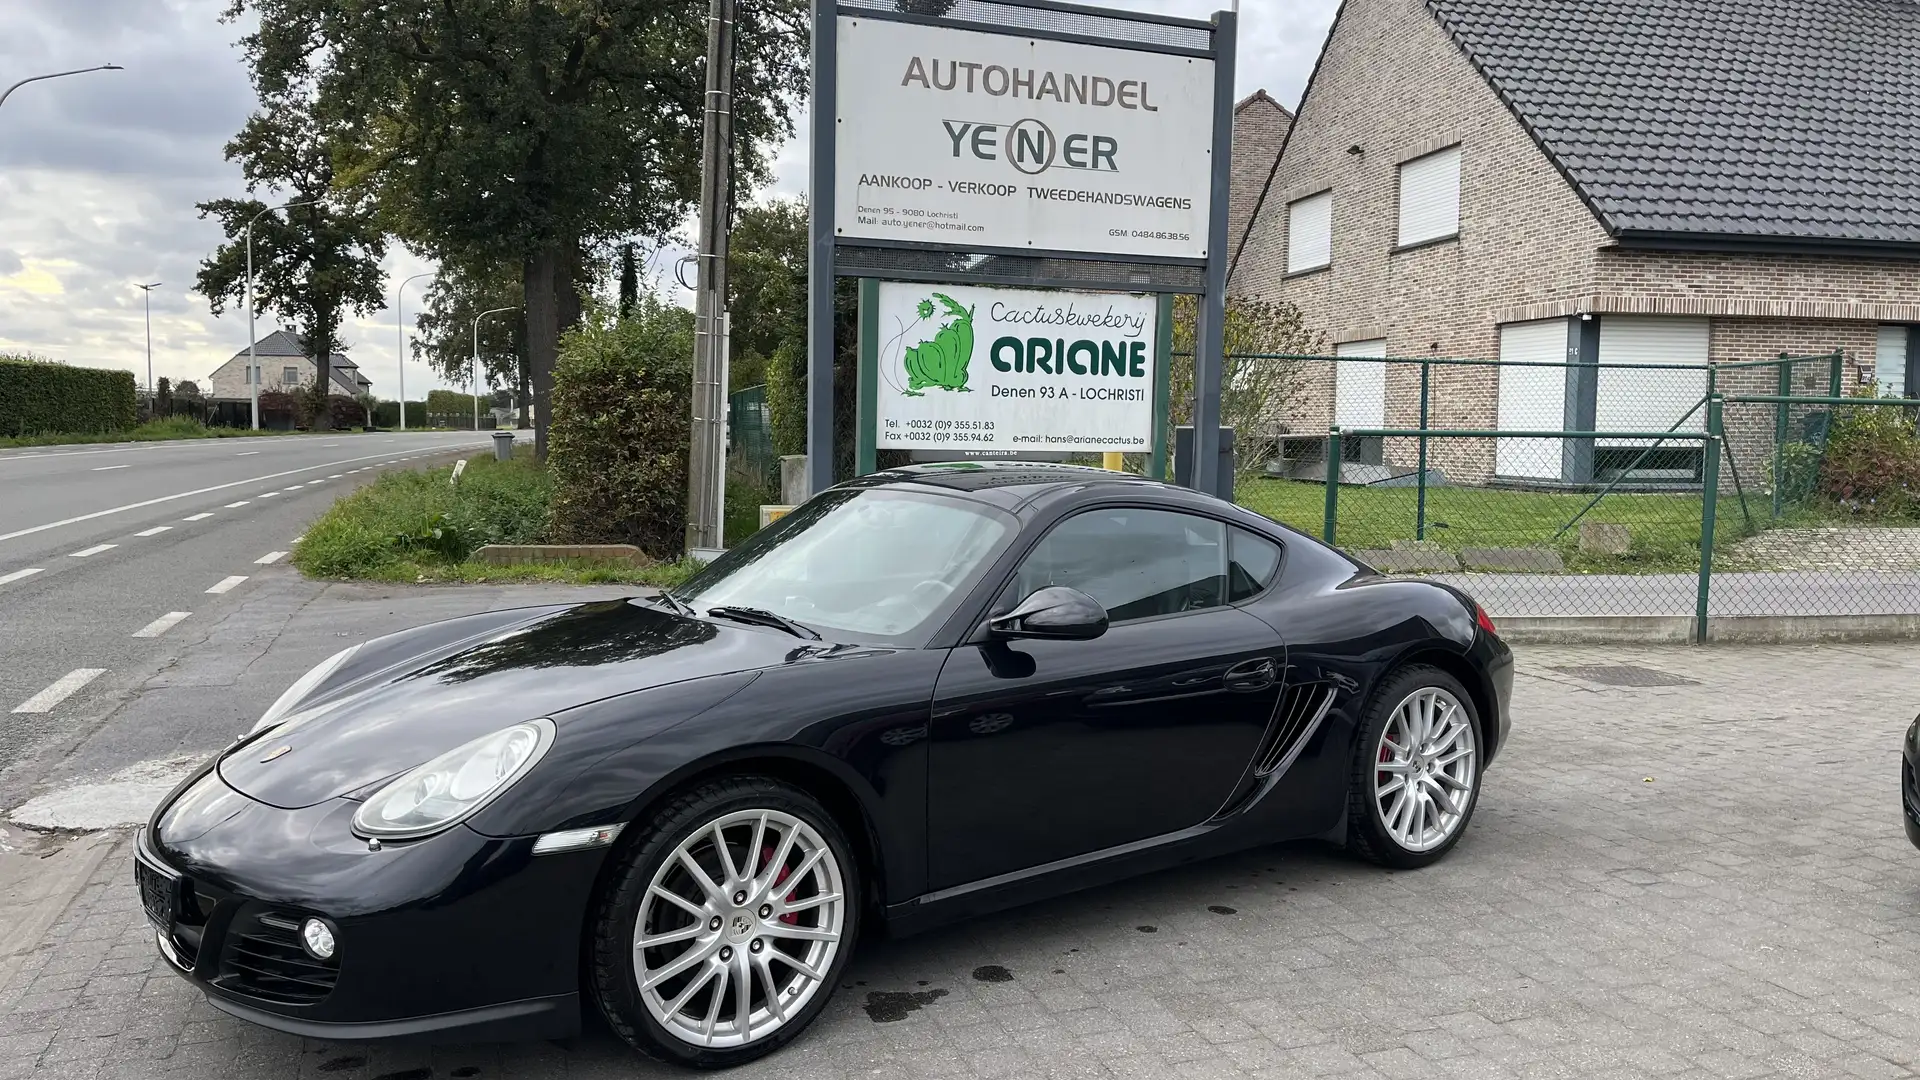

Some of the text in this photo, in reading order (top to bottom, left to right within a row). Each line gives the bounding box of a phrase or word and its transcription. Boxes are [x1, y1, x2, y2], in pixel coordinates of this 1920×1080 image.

[901, 56, 1158, 112] AUTOHANDEL
[942, 118, 1119, 175] YENER
[858, 174, 933, 190] AANKOOP
[948, 180, 1017, 197] VERKOOP
[1026, 186, 1192, 209] TWEEDEHANDSWAGENS
[857, 205, 881, 214] Denen
[883, 207, 895, 215] 95
[902, 208, 925, 217] 9080
[926, 210, 959, 219] Lochristi
[881, 218, 985, 232] auto.yener@hotmail.com
[990, 301, 1148, 338] Cactuskwekerij
[991, 385, 1036, 398] Denen
[1039, 386, 1055, 399] 93
[1058, 387, 1069, 399] A
[1080, 387, 1144, 401] LOCHRISTI
[885, 418, 995, 431] Tel. +0032 (0)9 355.51.83
[885, 431, 994, 442] Fax +0032 (0)9 355.94.62
[1012, 434, 1145, 445] e-mail: hans@arianecactus.be
